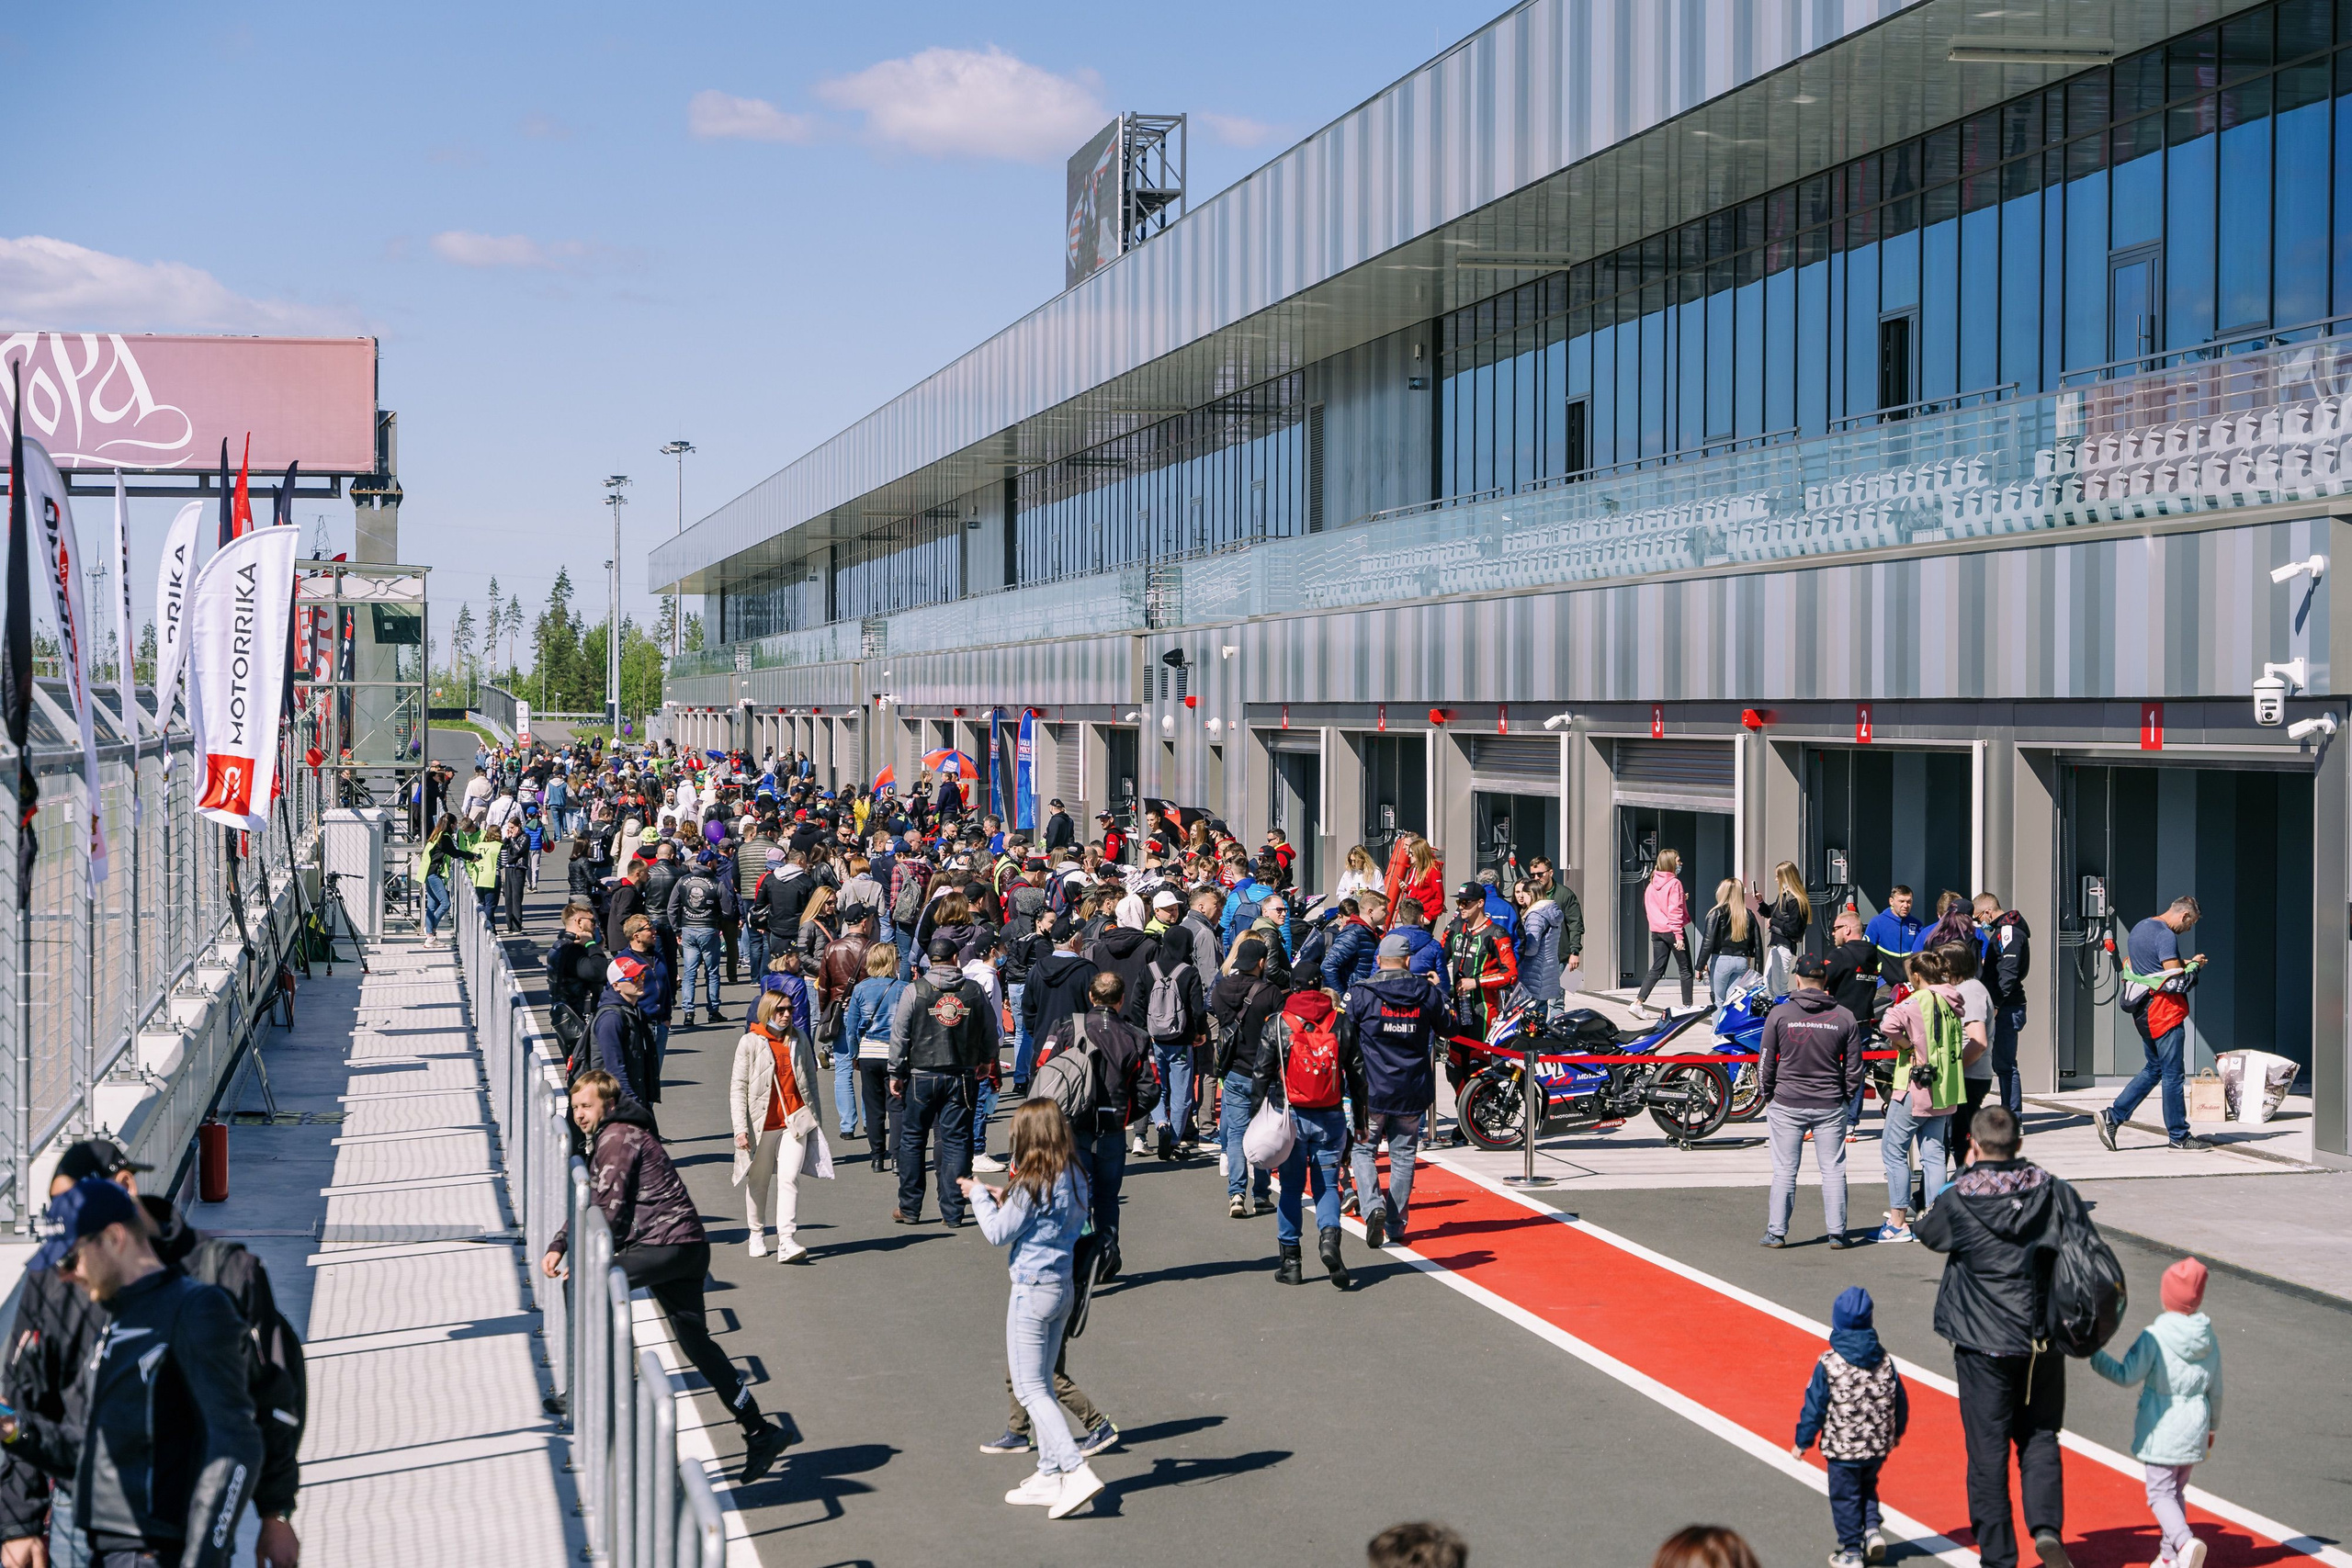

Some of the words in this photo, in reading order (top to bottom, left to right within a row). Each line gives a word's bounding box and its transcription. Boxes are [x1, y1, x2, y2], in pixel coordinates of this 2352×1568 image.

[230, 561, 257, 746] MOTORRIKA
[1499, 709, 1506, 729] 4
[1655, 709, 1661, 733] 3
[1860, 710, 1868, 737] 2
[2149, 710, 2155, 742] 1
[937, 997, 961, 1006] INDIAN
[1381, 1007, 1399, 1017] Red
[1400, 1008, 1420, 1019] Bull
[1383, 1022, 1408, 1032] Mobil
[1600, 1120, 1623, 1128] MOTUL
